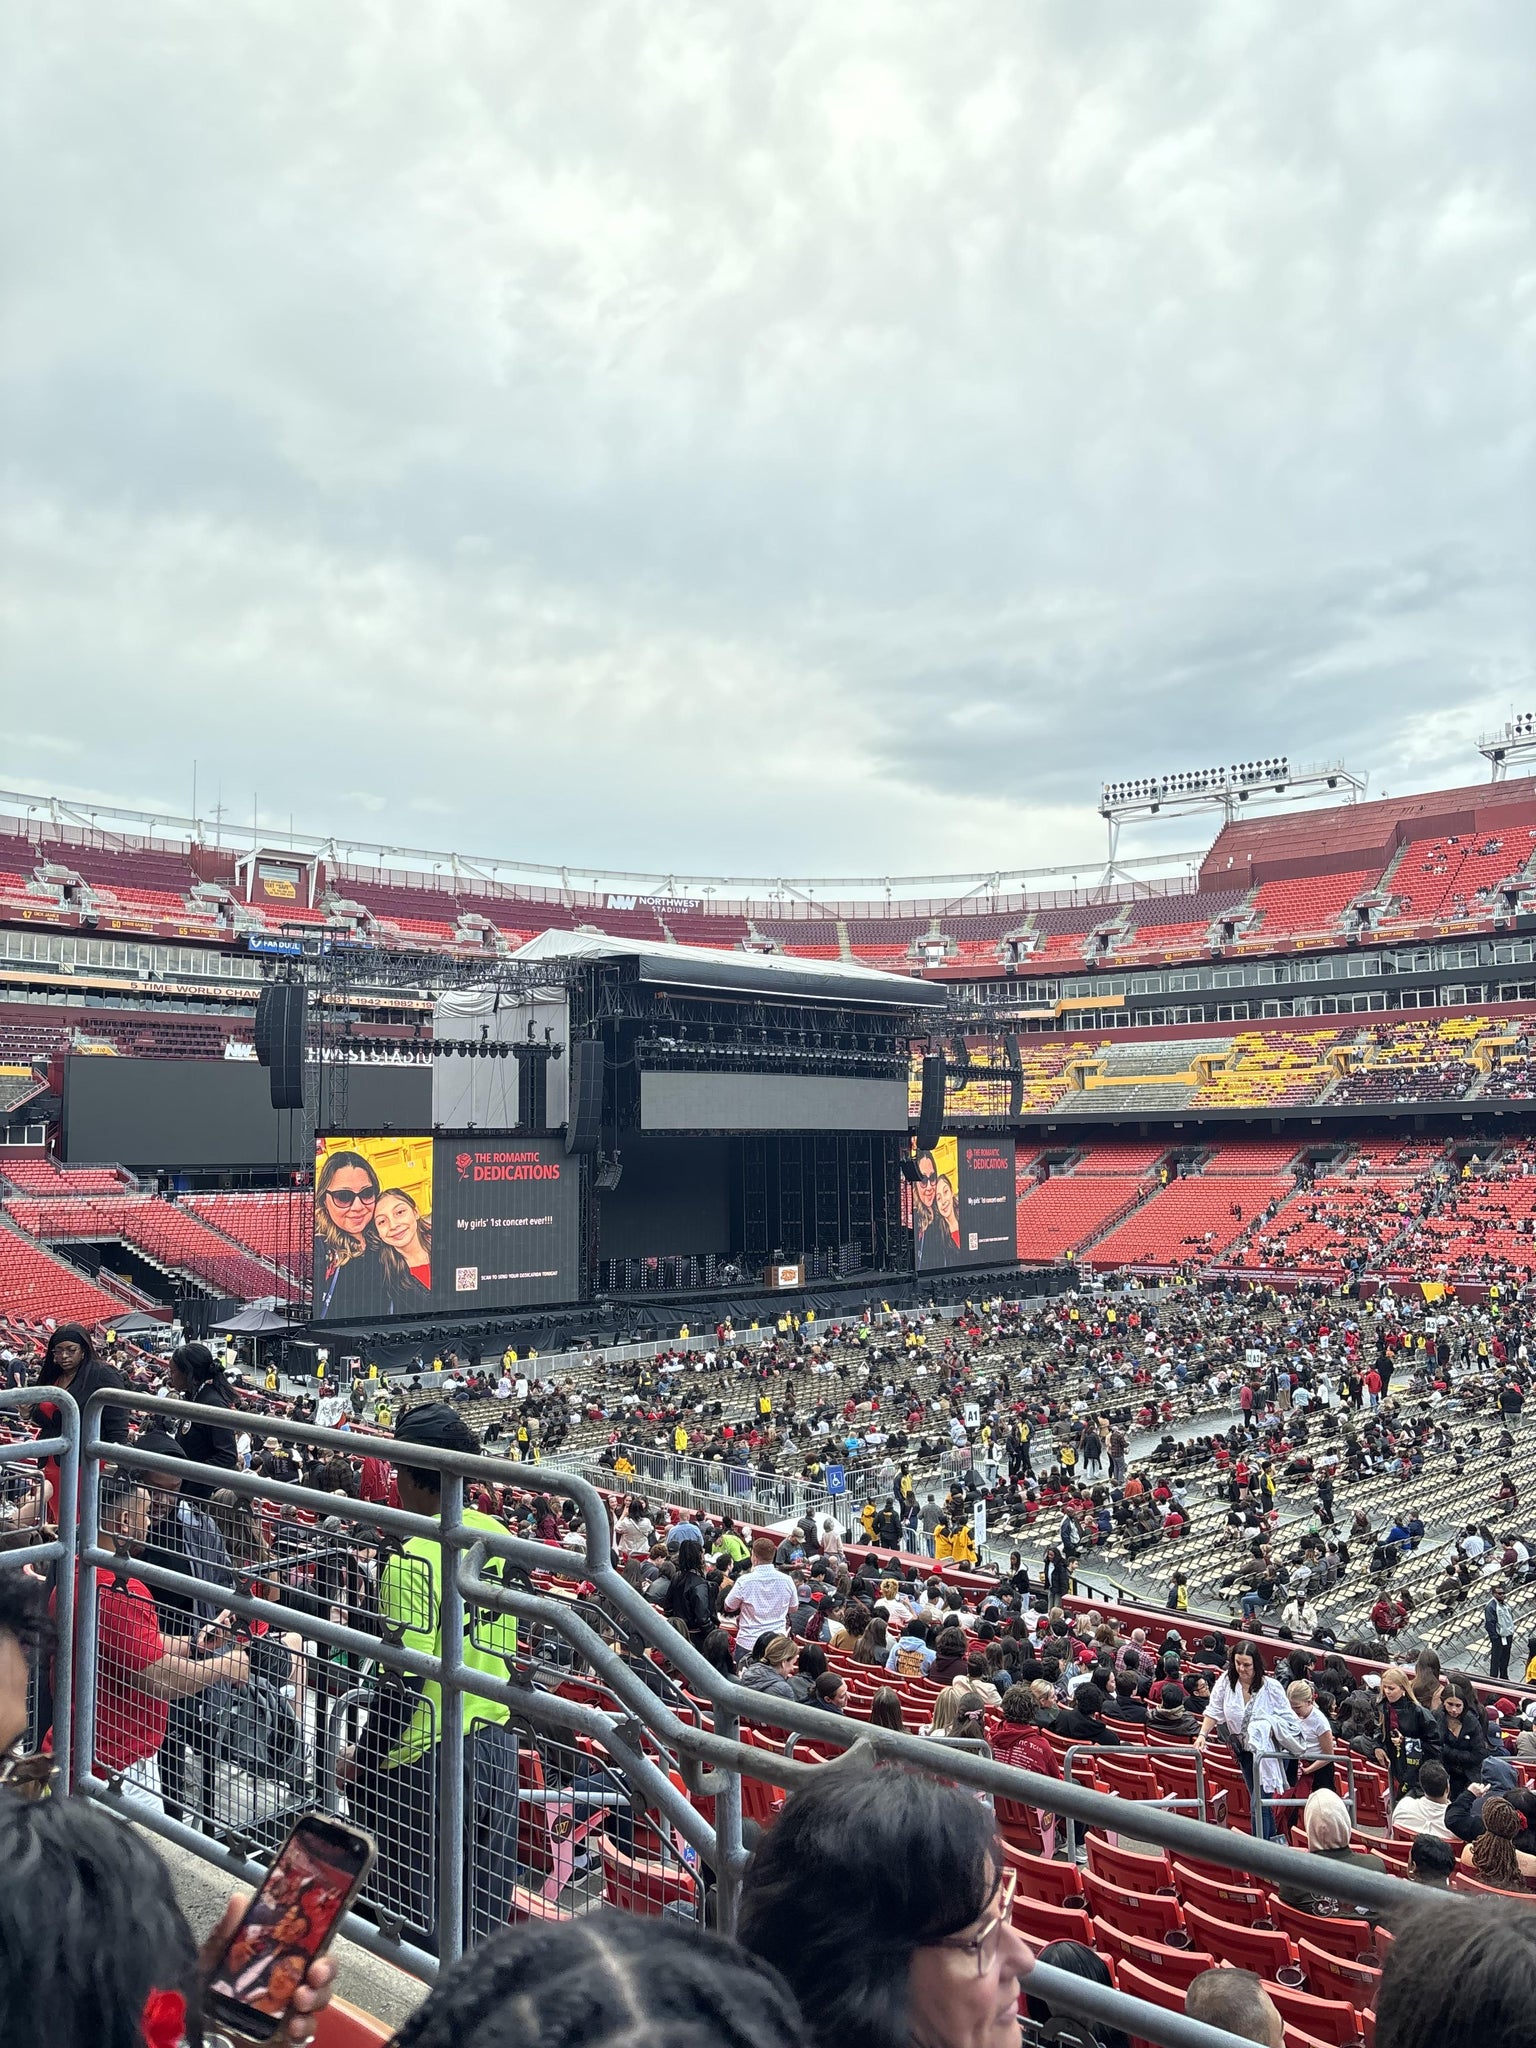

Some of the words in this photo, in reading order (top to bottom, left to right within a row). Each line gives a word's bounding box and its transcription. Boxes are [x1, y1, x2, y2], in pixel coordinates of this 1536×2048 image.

[607, 895, 637, 910] NW
[640, 896, 700, 908] NORTHWEST
[22, 911, 32, 919] 47
[652, 906, 688, 914] STADIUM
[179, 928, 188, 936] 65
[1440, 926, 1449, 935] 33
[142, 983, 172, 992] TIME
[177, 985, 222, 996] WORLD
[390, 1000, 414, 1008] 1982
[371, 1044, 432, 1064] STADIU
[474, 1153, 492, 1163] THE
[493, 1152, 540, 1163] ROMANTIC
[974, 1158, 1008, 1169] DEDICATIONS
[473, 1164, 560, 1181] DEDICATIONS
[457, 1219, 469, 1230] My
[490, 1217, 502, 1227] 1st
[502, 1217, 529, 1227] concert
[529, 1215, 553, 1226] ever!!!
[1426, 1321, 1436, 1329] A3
[1253, 1354, 1260, 1363] A2
[968, 1410, 978, 1421] A1
